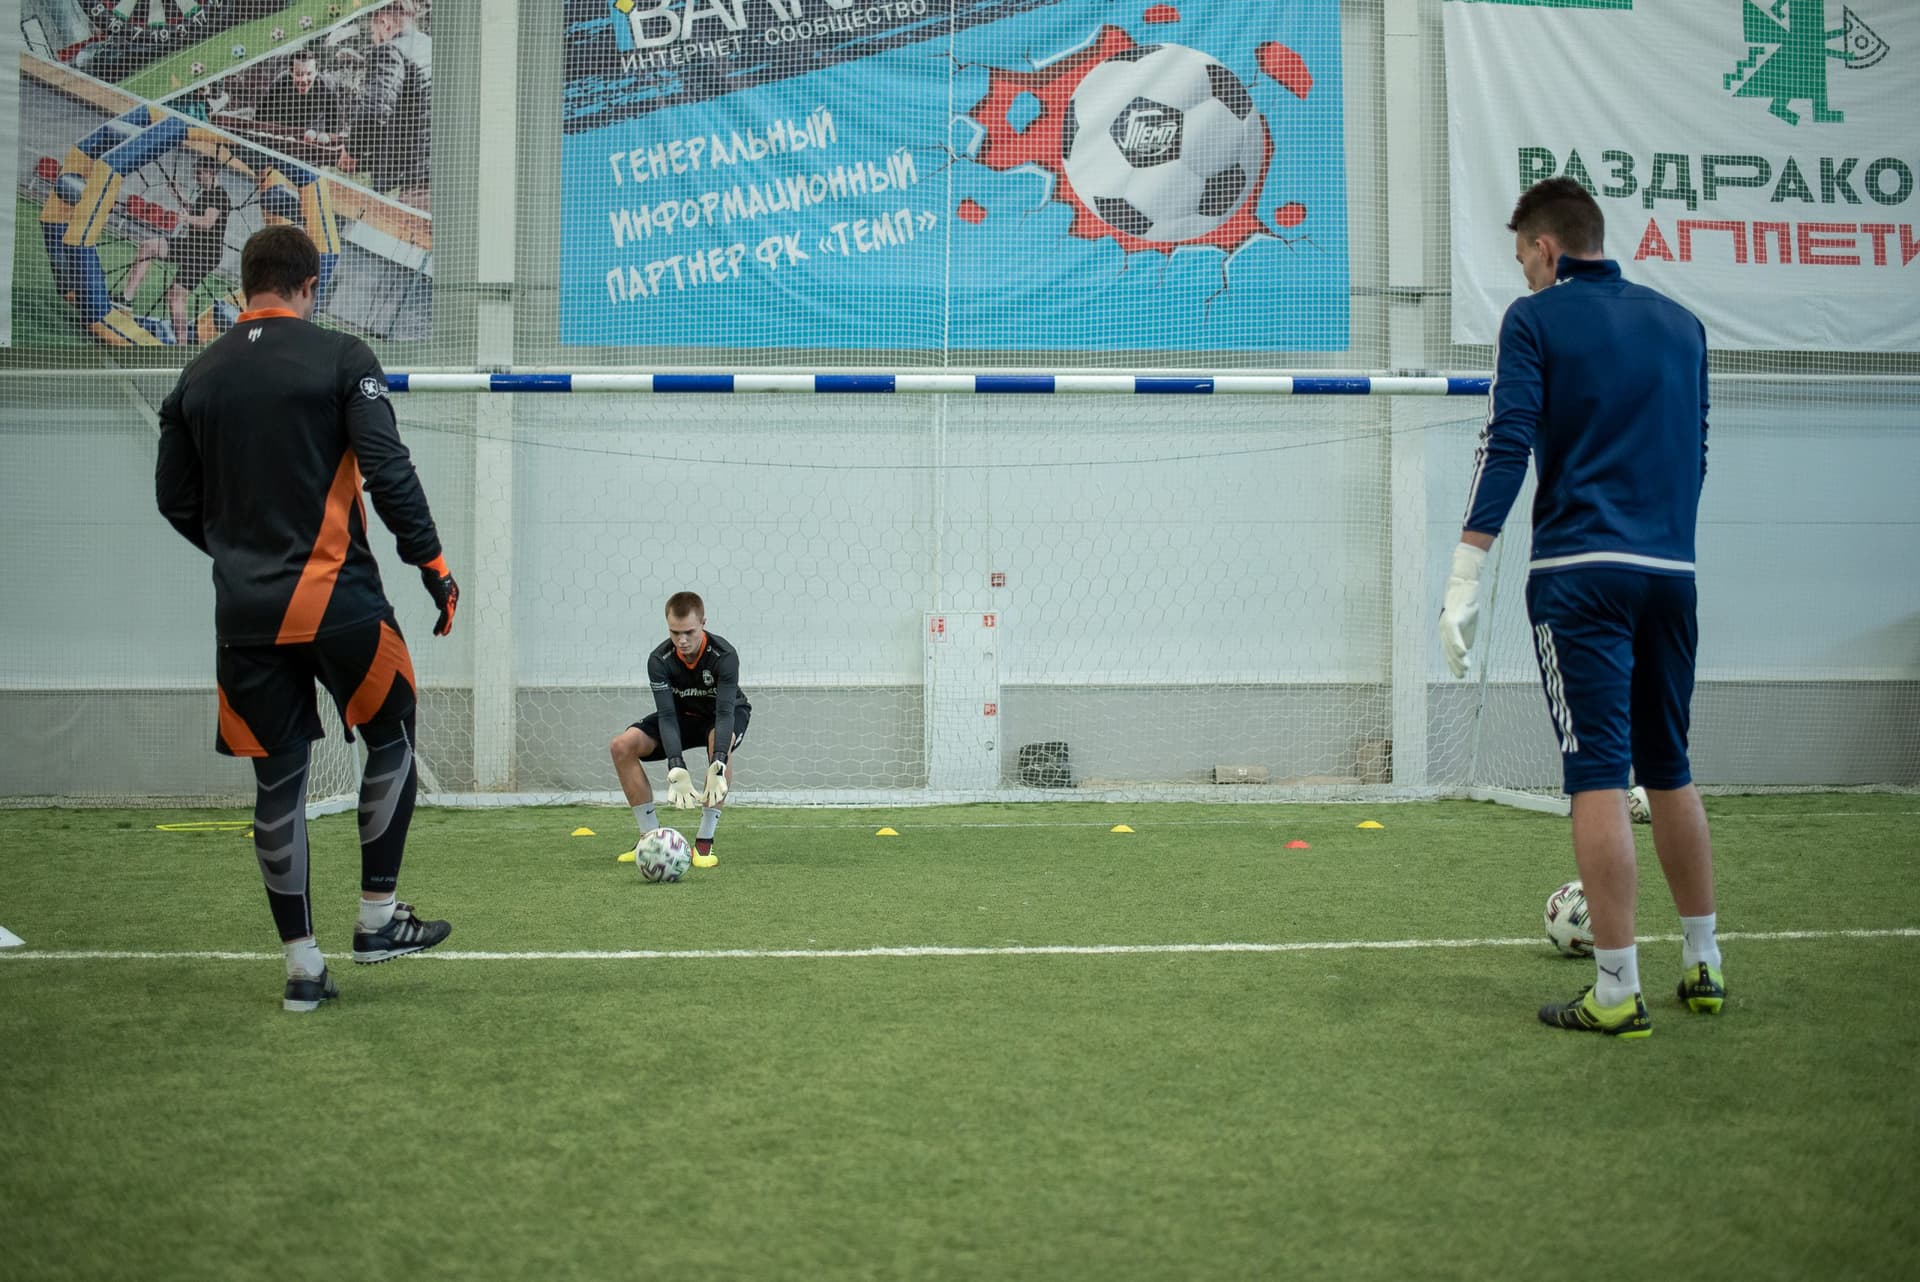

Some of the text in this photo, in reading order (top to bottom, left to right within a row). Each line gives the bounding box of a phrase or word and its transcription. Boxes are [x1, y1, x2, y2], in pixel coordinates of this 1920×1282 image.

[620, 35, 742, 73] ИНТЕРНЕТ
[764, 0, 927, 46] СООБЩЕСТВО
[609, 106, 838, 186] ГЕНЕРАЛЬНЫЙ
[607, 146, 918, 249] ИНФОРМАЦИОННЫЙ
[605, 208, 938, 304] ПАРТНЕР ФК «ТЕМП»
